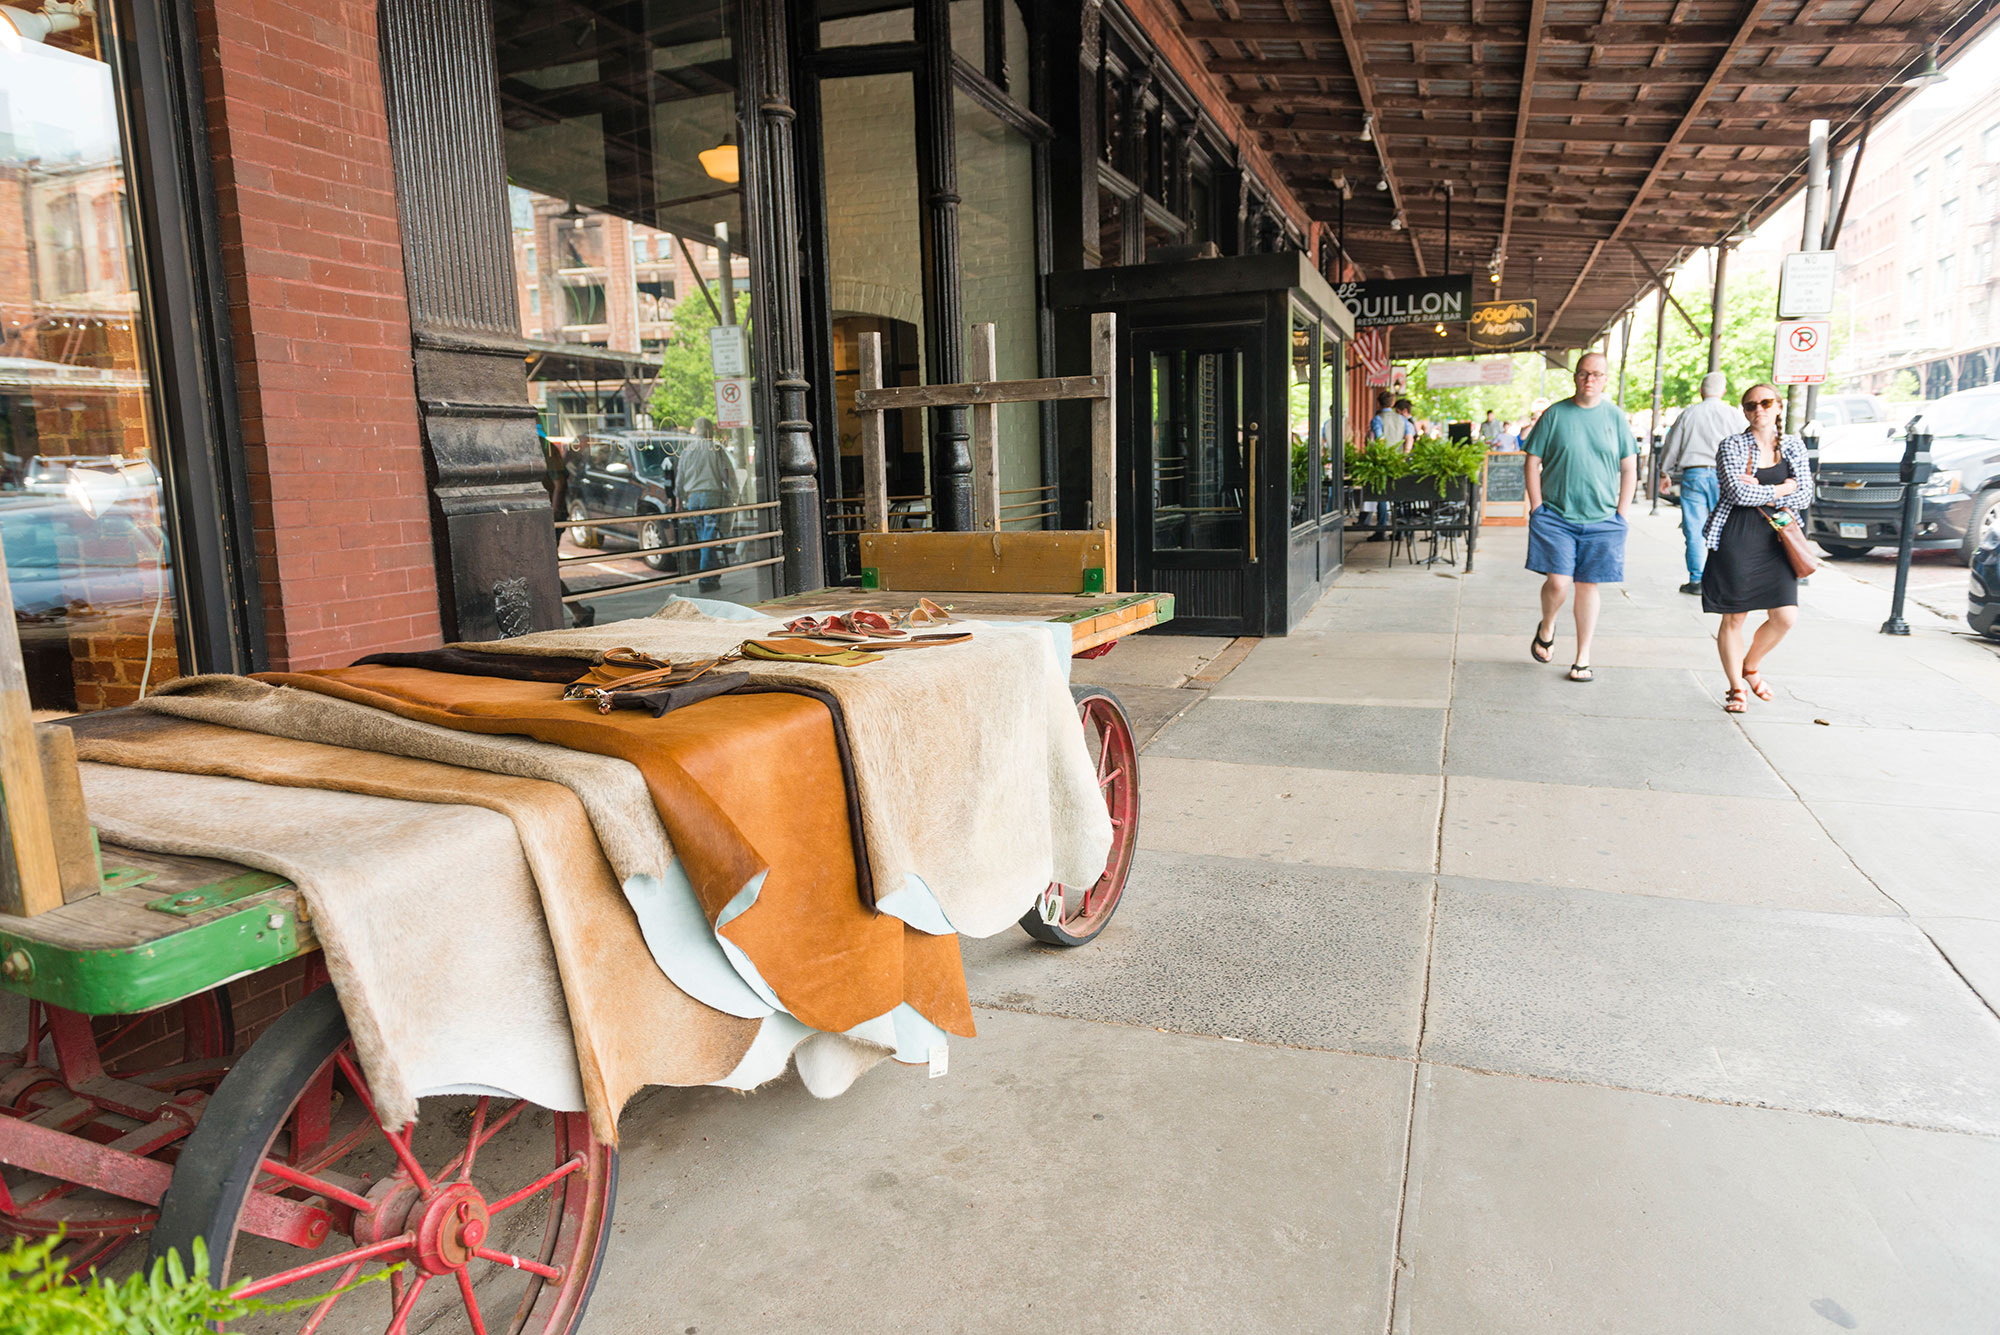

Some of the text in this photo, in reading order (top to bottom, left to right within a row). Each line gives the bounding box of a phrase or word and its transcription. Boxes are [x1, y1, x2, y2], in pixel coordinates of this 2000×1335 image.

[1356, 315, 1412, 326] RESTAURANT
[1422, 313, 1442, 321] RAW
[1443, 312, 1462, 320] BAR
